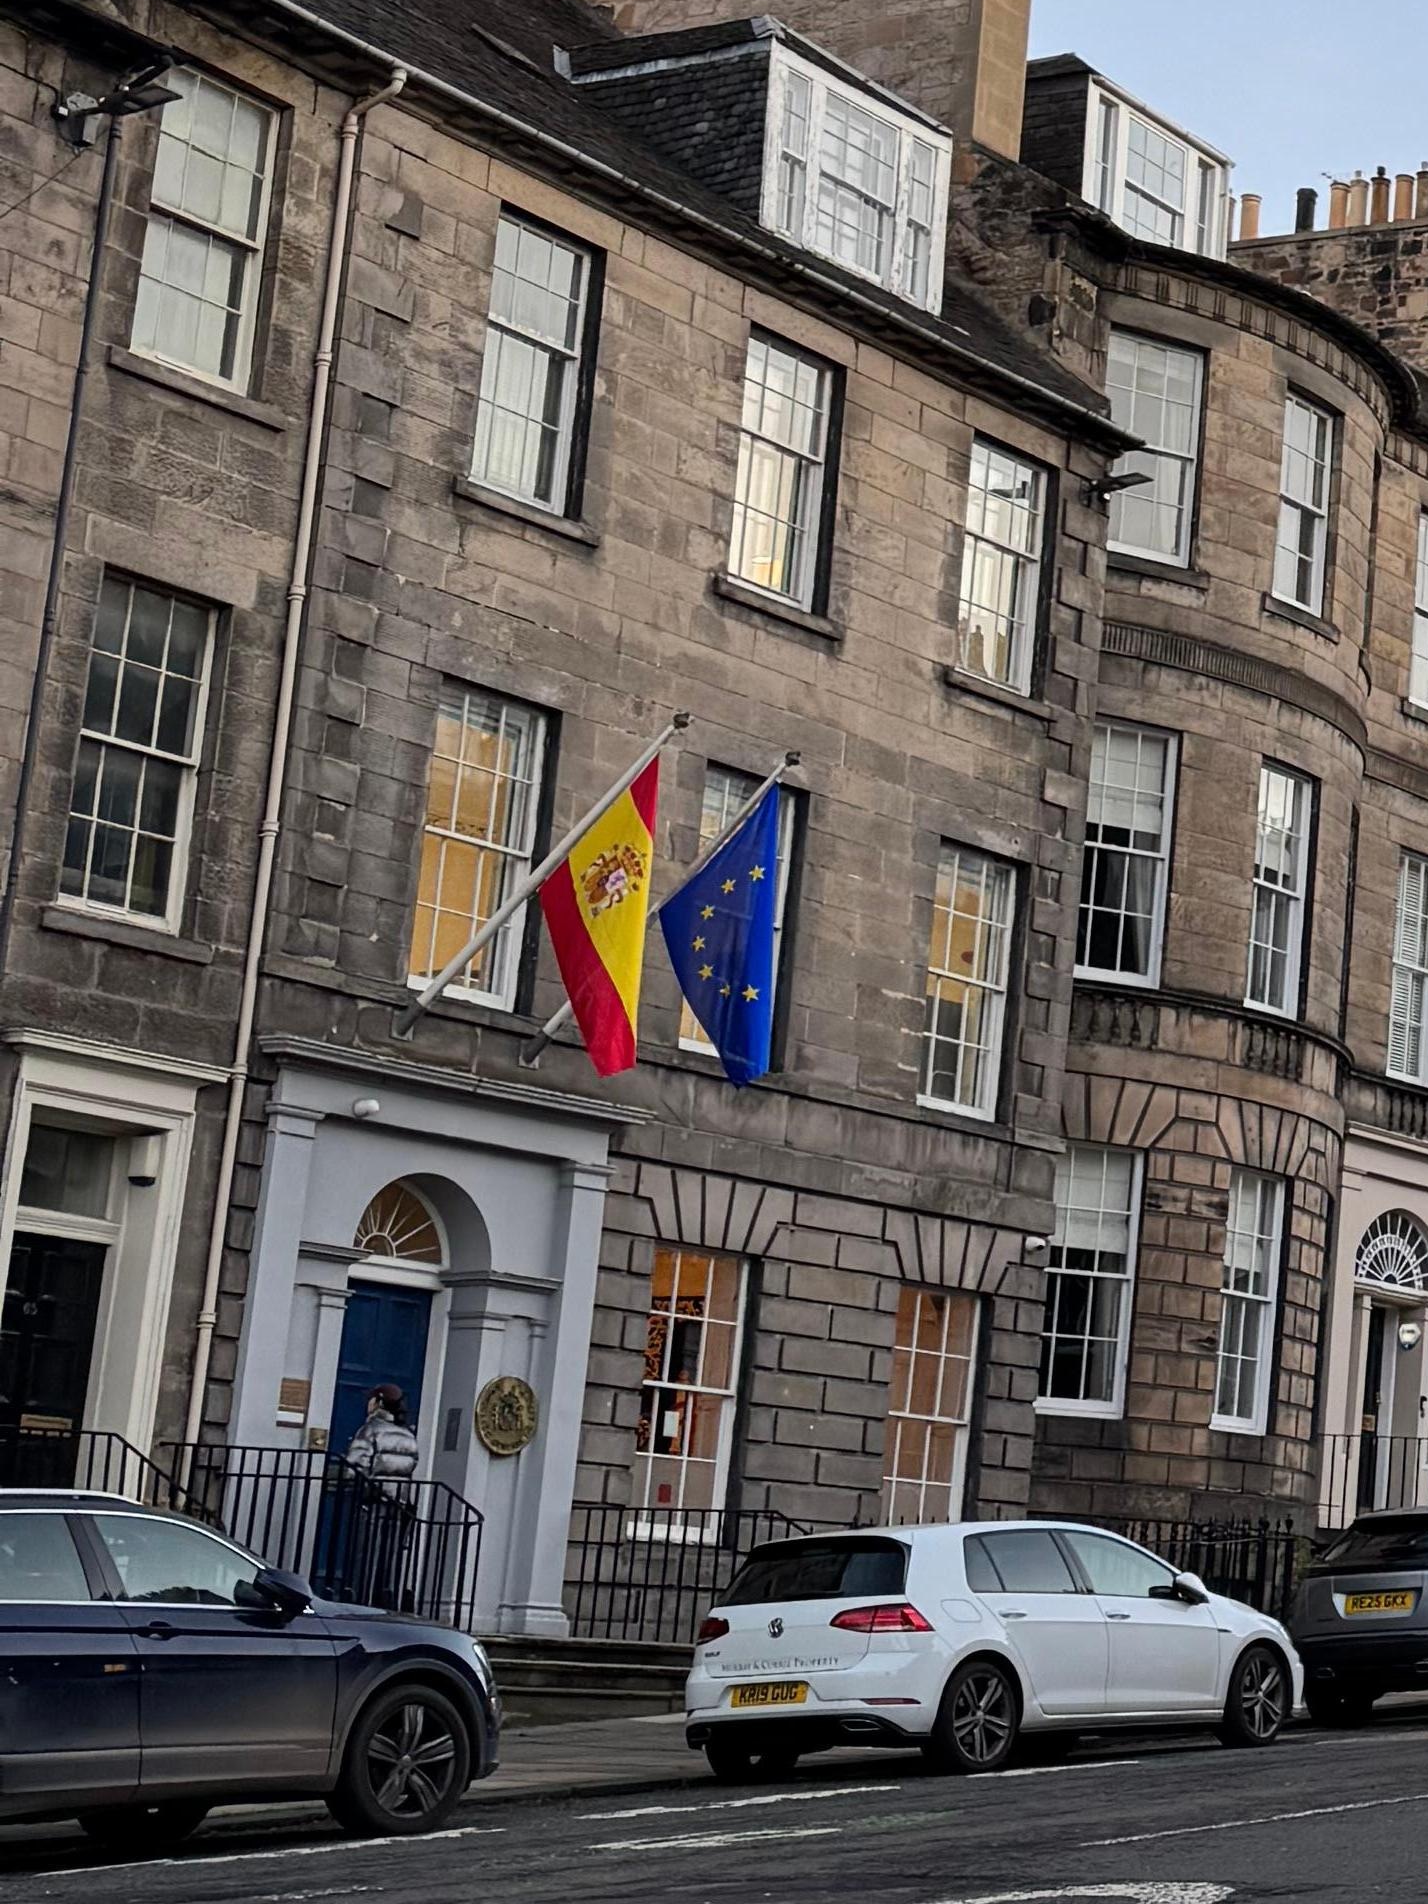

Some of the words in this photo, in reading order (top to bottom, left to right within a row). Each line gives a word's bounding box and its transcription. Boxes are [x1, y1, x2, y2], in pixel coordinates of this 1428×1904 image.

[1384, 1593, 1408, 1607] GKX
[739, 1685, 768, 1703] KR19
[771, 1683, 799, 1700] GUG
